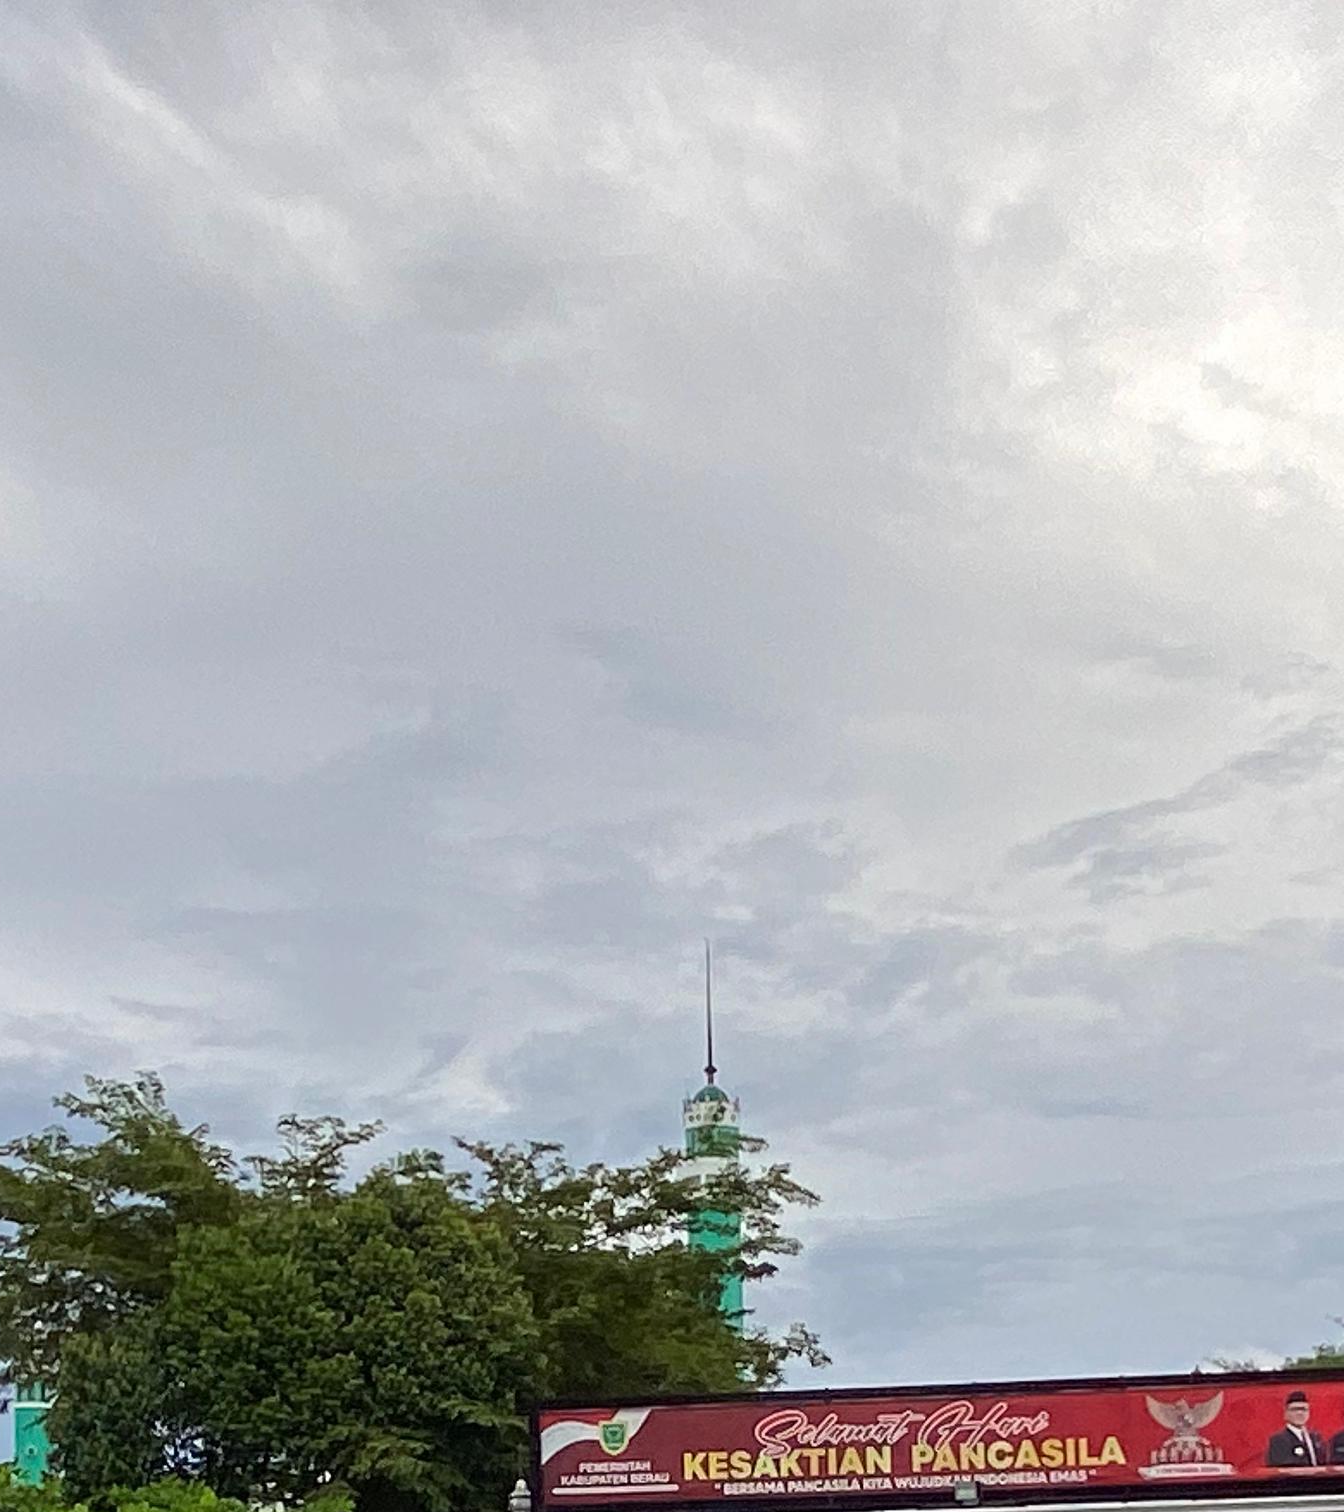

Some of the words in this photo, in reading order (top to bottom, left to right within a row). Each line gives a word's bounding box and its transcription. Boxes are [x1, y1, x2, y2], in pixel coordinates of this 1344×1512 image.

[918, 1400, 1049, 1451] Hari
[683, 1445, 892, 1480] KESAKTIAN
[911, 1436, 1126, 1473] PANCASILA
[579, 1461, 651, 1473] PEMERINTAH
[560, 1473, 628, 1485] KABUPATEN
[630, 1471, 669, 1483] BERAU
[787, 1478, 861, 1493] PANCASILA
[863, 1477, 892, 1490] KITA
